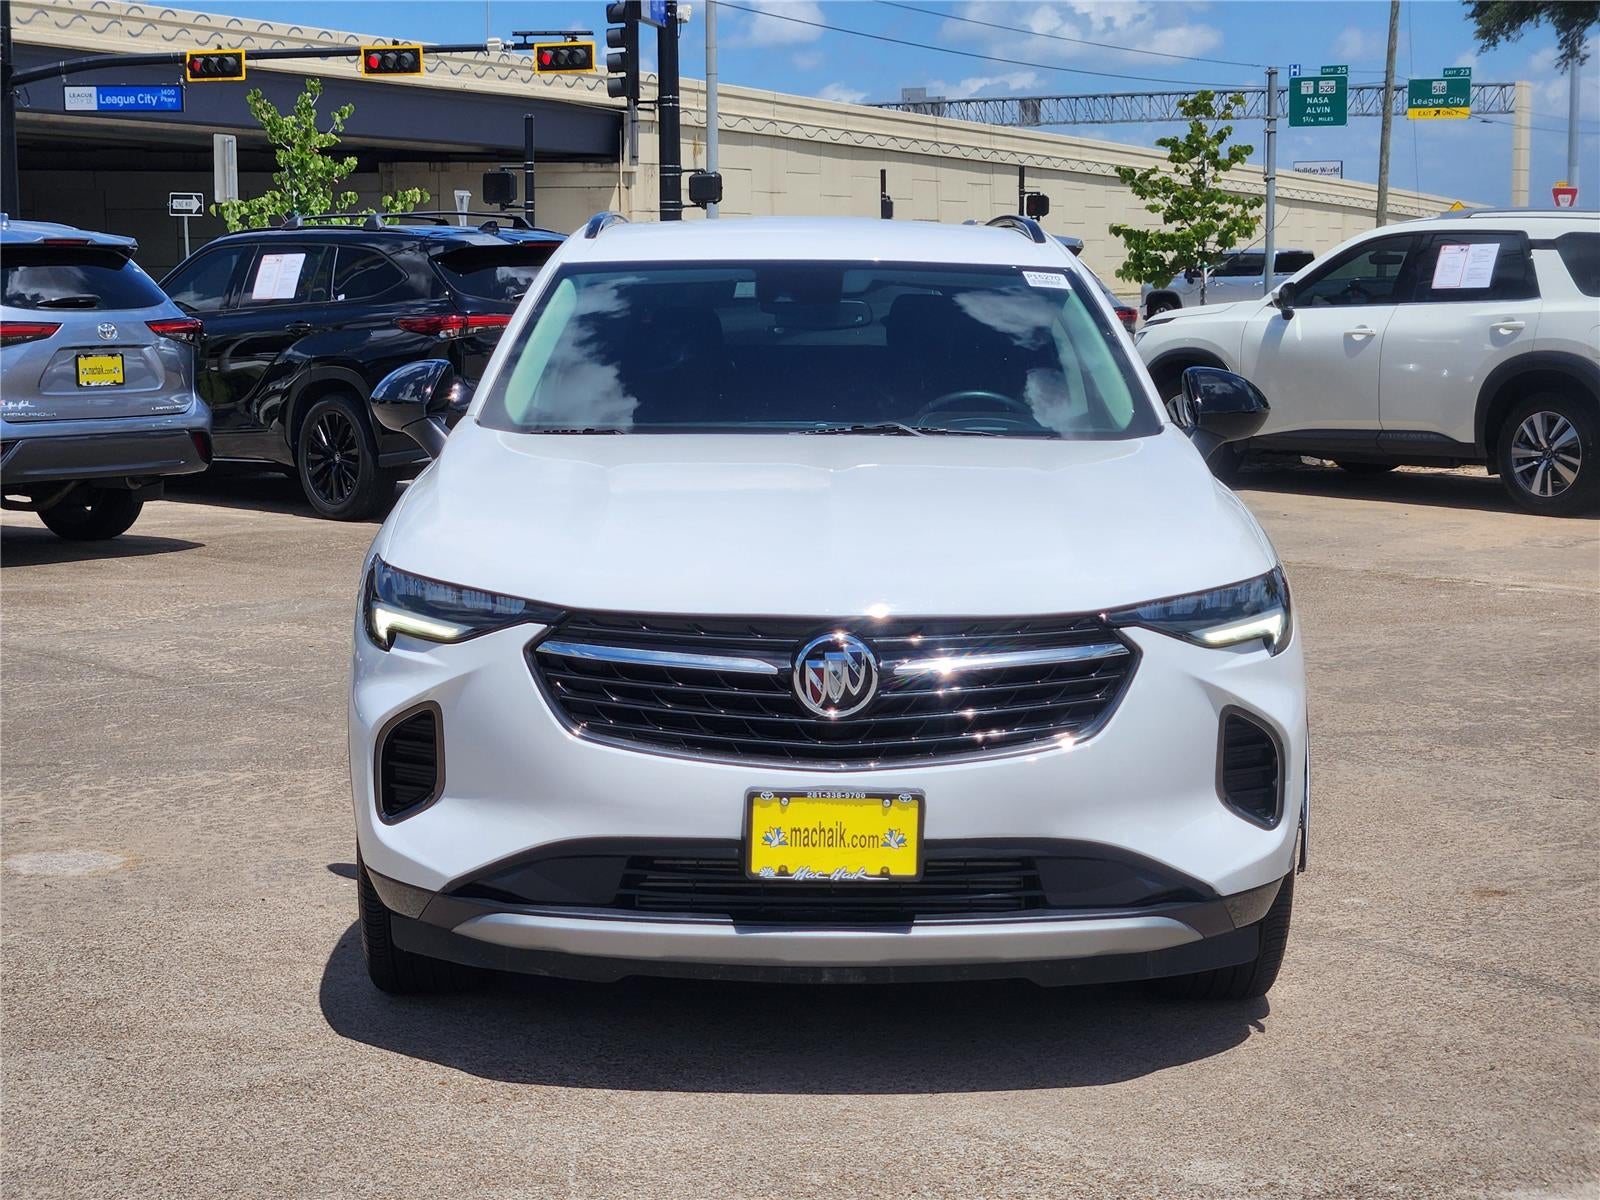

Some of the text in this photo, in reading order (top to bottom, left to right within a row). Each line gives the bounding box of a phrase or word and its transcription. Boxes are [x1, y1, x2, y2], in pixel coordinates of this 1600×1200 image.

[1290, 64, 1300, 76] H
[1336, 66, 1347, 74] 25
[160, 88, 176, 96] 1400
[1320, 84, 1335, 92] 528
[1432, 85, 1446, 94] 518
[99, 94, 136, 107] League
[137, 93, 158, 107] City
[160, 96, 177, 104] Pkwy
[1306, 96, 1329, 104] NASA
[1412, 96, 1466, 106] League City
[1306, 106, 1331, 114] ALVIN
[1294, 166, 1319, 174] Holiday
[1319, 165, 1340, 173] World
[790, 821, 879, 849] machaik.com
[791, 865, 868, 881] Mac Haik
